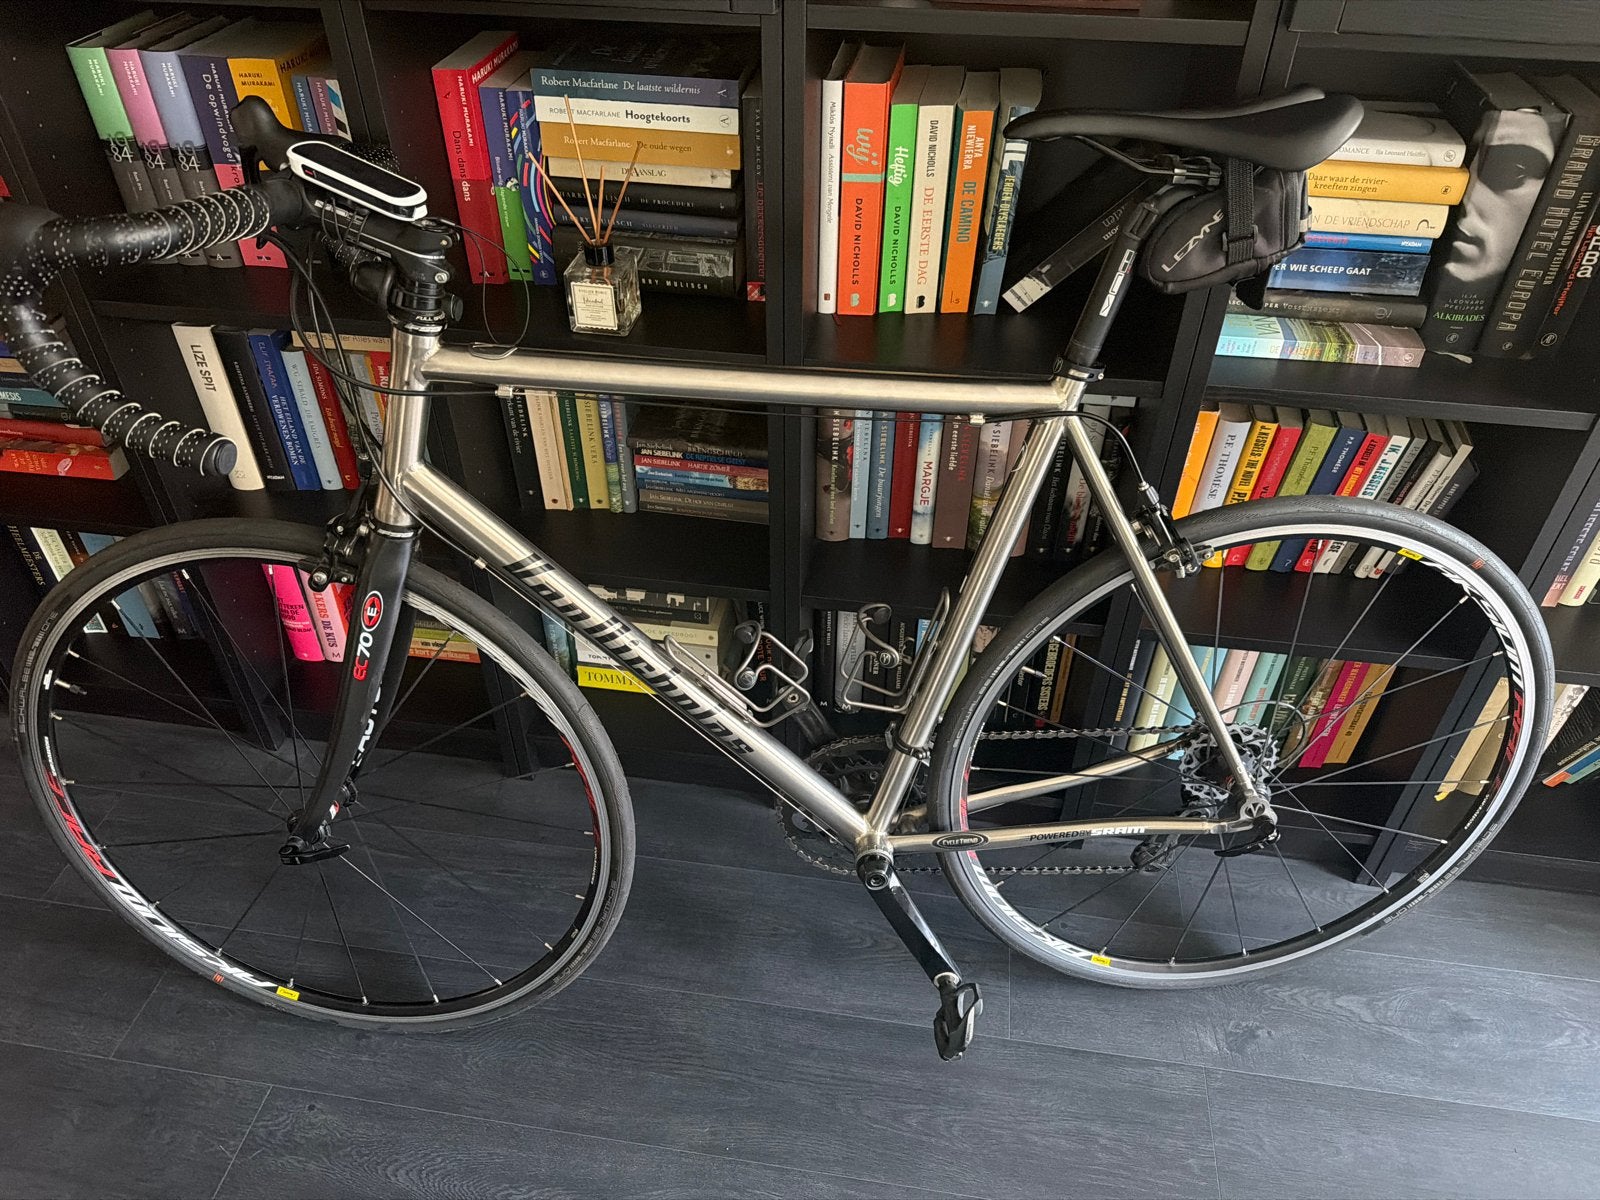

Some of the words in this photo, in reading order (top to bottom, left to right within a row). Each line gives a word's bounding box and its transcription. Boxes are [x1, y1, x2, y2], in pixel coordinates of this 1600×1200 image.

[161, 63, 175, 98] MURAKAMI
[210, 63, 221, 92] HARUKI
[471, 64, 493, 84] HARUKI
[541, 76, 570, 87] Robert
[572, 78, 619, 90] Macfarlane
[623, 80, 635, 90] De
[637, 82, 662, 93] laatste
[664, 84, 701, 95] wildernis
[296, 82, 306, 110] HARUKI
[316, 82, 326, 110] HARUKI
[458, 76, 467, 105] HARUKI
[203, 74, 212, 89] De
[209, 94, 236, 162] opwindvogel
[462, 107, 474, 147] MURAKAMI
[499, 92, 507, 120] HARUKI
[503, 122, 513, 161] MURAKAMI
[576, 108, 621, 118] MACFARLANE
[625, 109, 691, 124] Hoogtekoorts
[590, 137, 631, 148] Macfarlane
[636, 141, 648, 150] De
[649, 143, 667, 151] oude
[669, 144, 692, 152] wegen
[929, 120, 938, 143] DAVID
[111, 146, 133, 163] 84
[846, 128, 878, 166] wij
[963, 125, 976, 170] NIEWIERRA
[974, 137, 984, 158] ANYA
[145, 154, 166, 170] 84
[178, 156, 200, 172] 84
[452, 131, 463, 156] Dans
[458, 158, 466, 178] dans
[462, 181, 471, 202] dans
[889, 146, 909, 187] Heftig
[926, 145, 937, 178] NICHOLLS
[1553, 135, 1600, 200] GRAND
[962, 182, 976, 195] DE
[1308, 173, 1328, 181] Daar
[1313, 182, 1348, 190] kreeften
[1350, 184, 1377, 194] zingen
[924, 187, 934, 205] DE
[1577, 192, 1593, 208] ILJA
[855, 198, 863, 229] DAVID
[893, 206, 901, 235] DAVID
[956, 200, 974, 243] CAMINO
[1325, 216, 1338, 225] DE
[1340, 217, 1410, 229] VRIENDSCHAP
[920, 210, 932, 256] EERSTE
[1161, 209, 1224, 272] LEZYNE
[1526, 206, 1571, 261] HOTEL
[1561, 211, 1585, 246] LEONARD
[852, 234, 861, 285] NICHOLLS
[889, 239, 899, 285] NICHOLLS
[917, 260, 928, 285] DAG
[1290, 264, 1307, 272] WIE
[1309, 265, 1344, 274] SCHEEP
[1346, 267, 1372, 276] GAAT
[1542, 248, 1568, 286] PFEIJFFER
[666, 281, 708, 290] MULISCH
[1496, 268, 1543, 331] EUROPA
[1433, 311, 1485, 322] ALKIBIADES
[190, 344, 208, 372] LIZE
[200, 370, 216, 392] SPIT
[316, 378, 328, 400] SIMONS
[272, 394, 289, 439] VERDWENEN
[285, 439, 299, 466] BOMEN
[584, 401, 594, 442] SIEBELINK
[600, 401, 609, 438] SIEBELINK
[832, 418, 840, 461] SIEBELINK
[880, 425, 888, 465] SIEBELINK
[989, 429, 1000, 475] SIEBELINK
[1225, 434, 1237, 449] P.F.
[1347, 436, 1355, 445] P.F.
[1384, 444, 1402, 456] IK,
[652, 450, 683, 459] SIEBELINK
[653, 458, 680, 467] SIEBELINK
[948, 452, 957, 471] liefde
[1245, 459, 1259, 470] THE
[1332, 447, 1350, 474] THOMÉSE
[878, 467, 886, 477] De
[920, 461, 933, 506] MARGJE
[1207, 453, 1230, 500] THOMÉSE
[1238, 471, 1255, 487] NOVEL
[7, 525, 46, 587] HEELMEESTERS
[32, 551, 40, 561] DE
[321, 620, 333, 631] DE
[325, 632, 338, 648] KUS
[353, 632, 373, 681] EC70
[586, 671, 637, 686] TOMMY
[1037, 684, 1051, 711] SISTERS
[1029, 831, 1079, 842] POWERED
[1091, 826, 1149, 837] SRAM
[109, 880, 279, 988] AKSIUM
